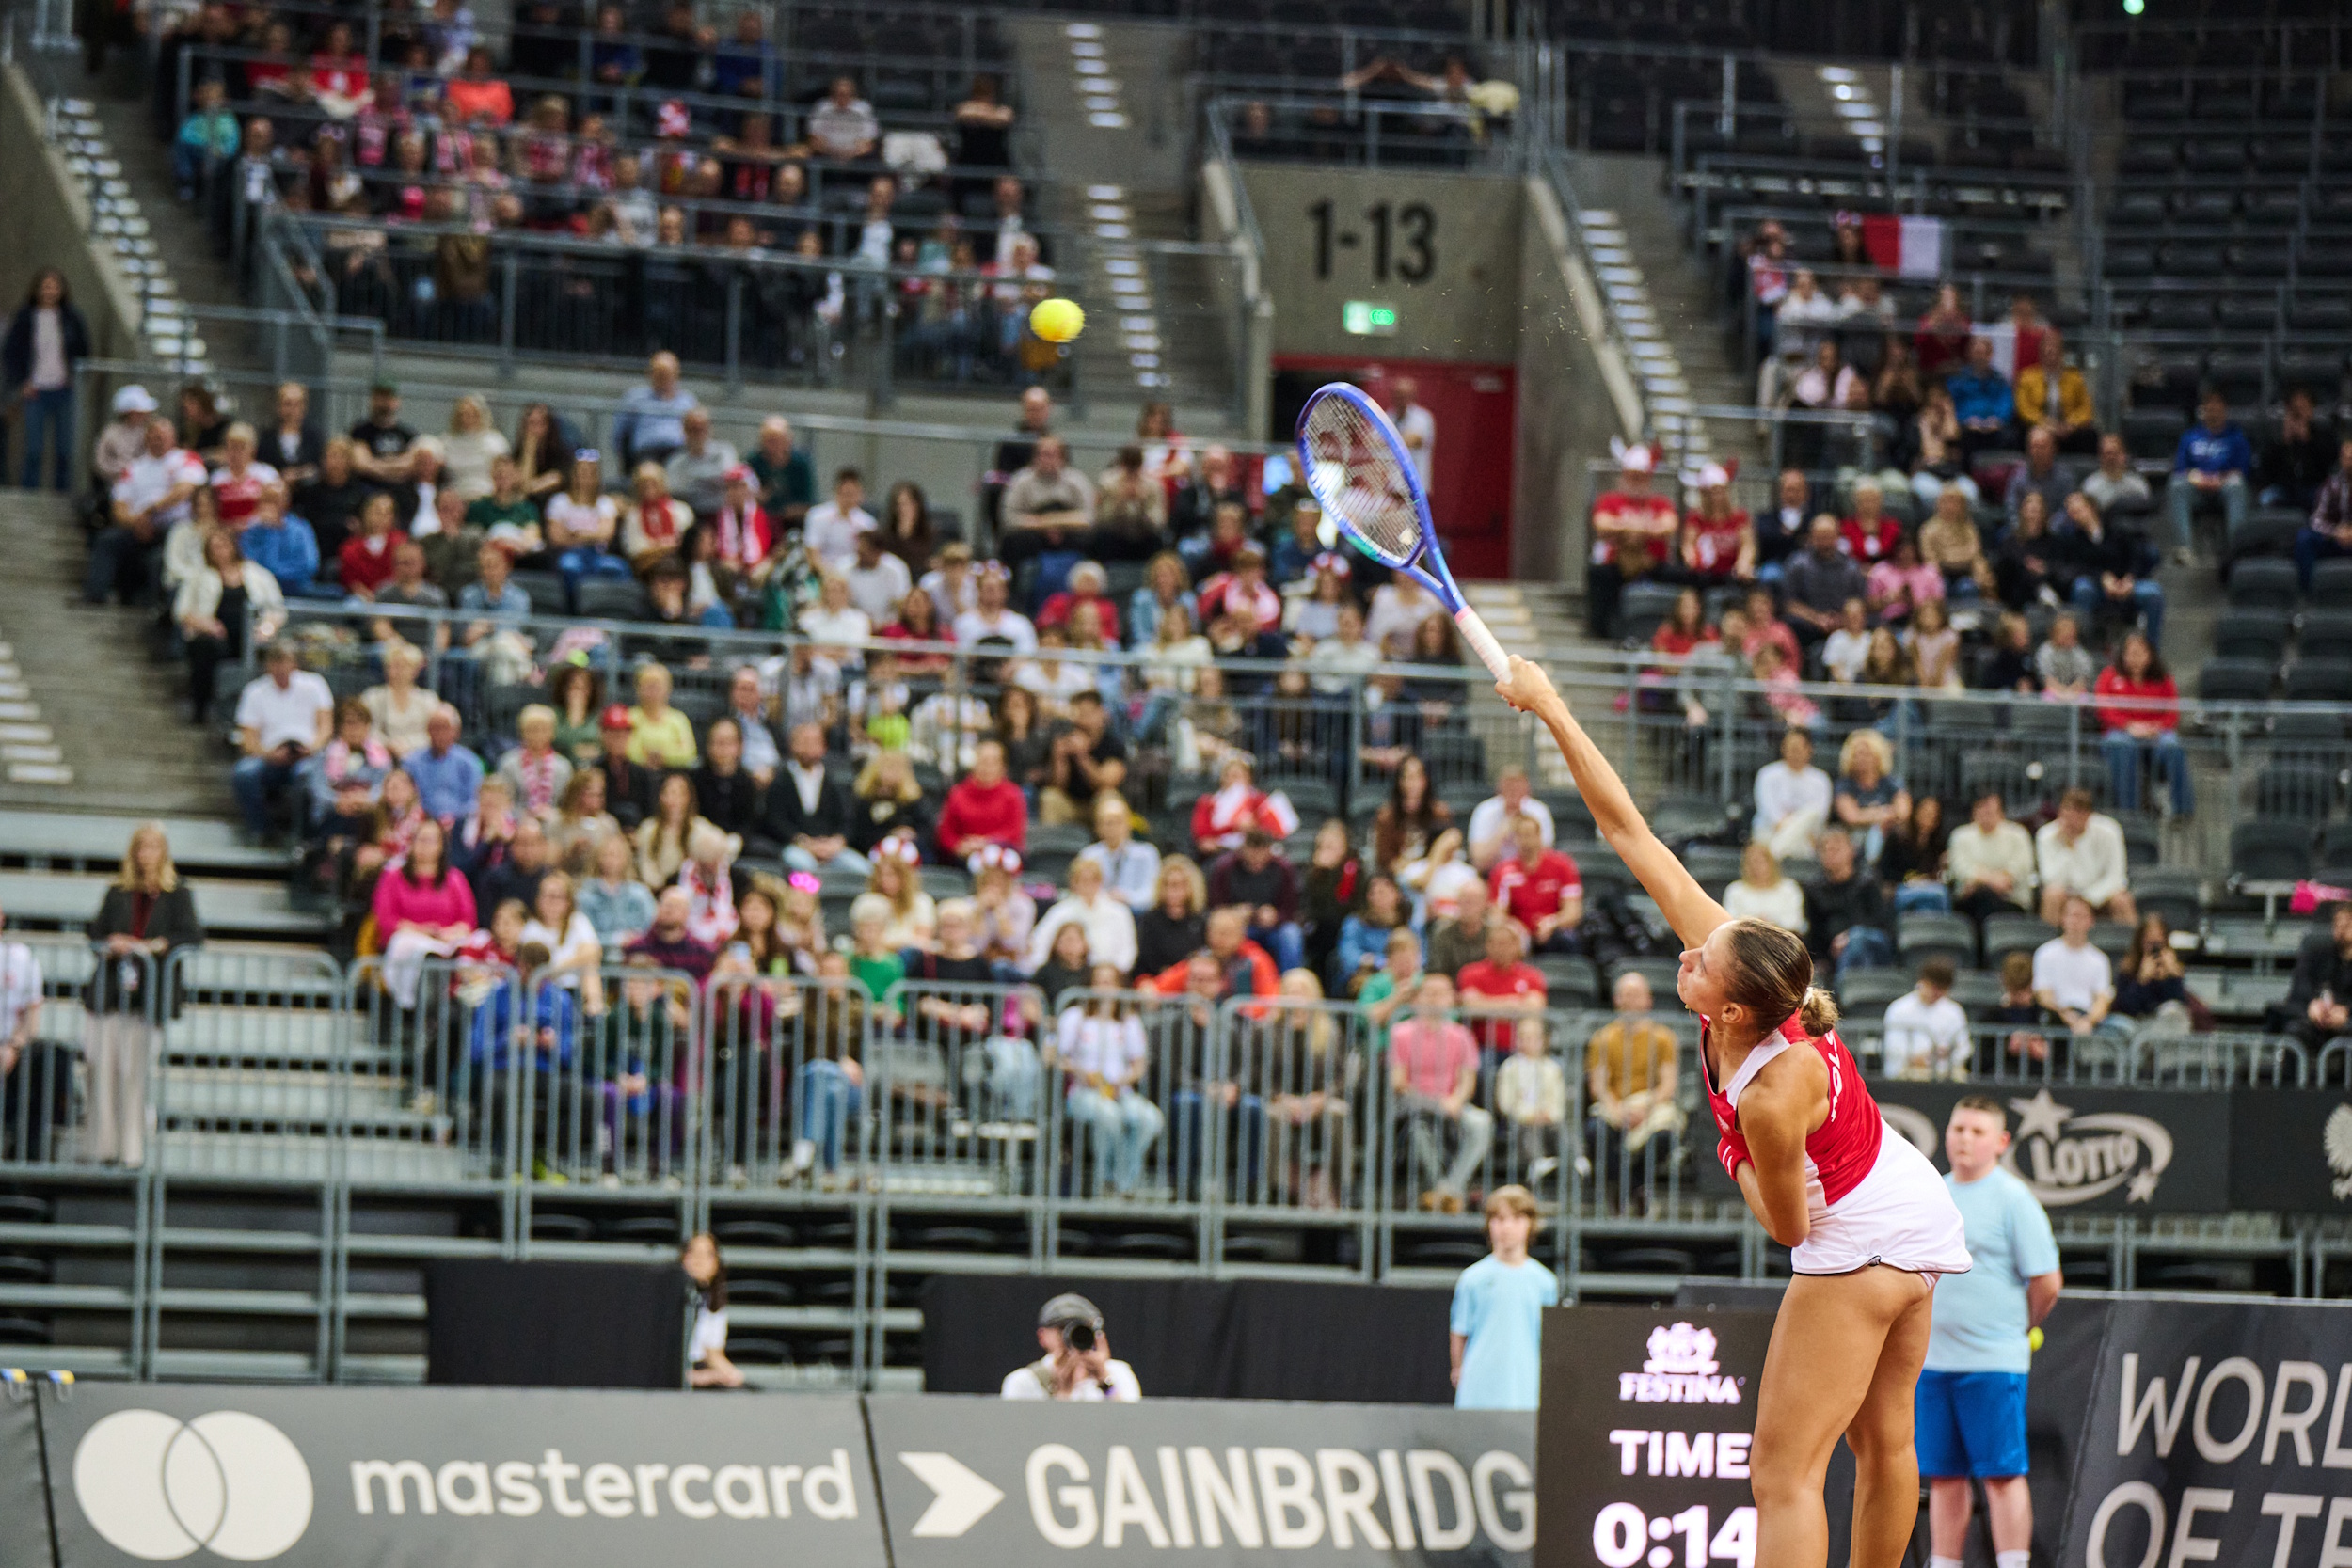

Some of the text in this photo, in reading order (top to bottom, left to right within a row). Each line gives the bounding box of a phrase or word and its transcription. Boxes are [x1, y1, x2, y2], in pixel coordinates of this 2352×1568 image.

[1306, 198, 1435, 283] 1-13
[1618, 1372, 1741, 1404] FESTINA
[350, 1449, 858, 1520] mastercard
[1609, 1430, 1752, 1479] TIME
[1593, 1502, 1757, 1568] 0:14
[2086, 1481, 2234, 1568] OF
